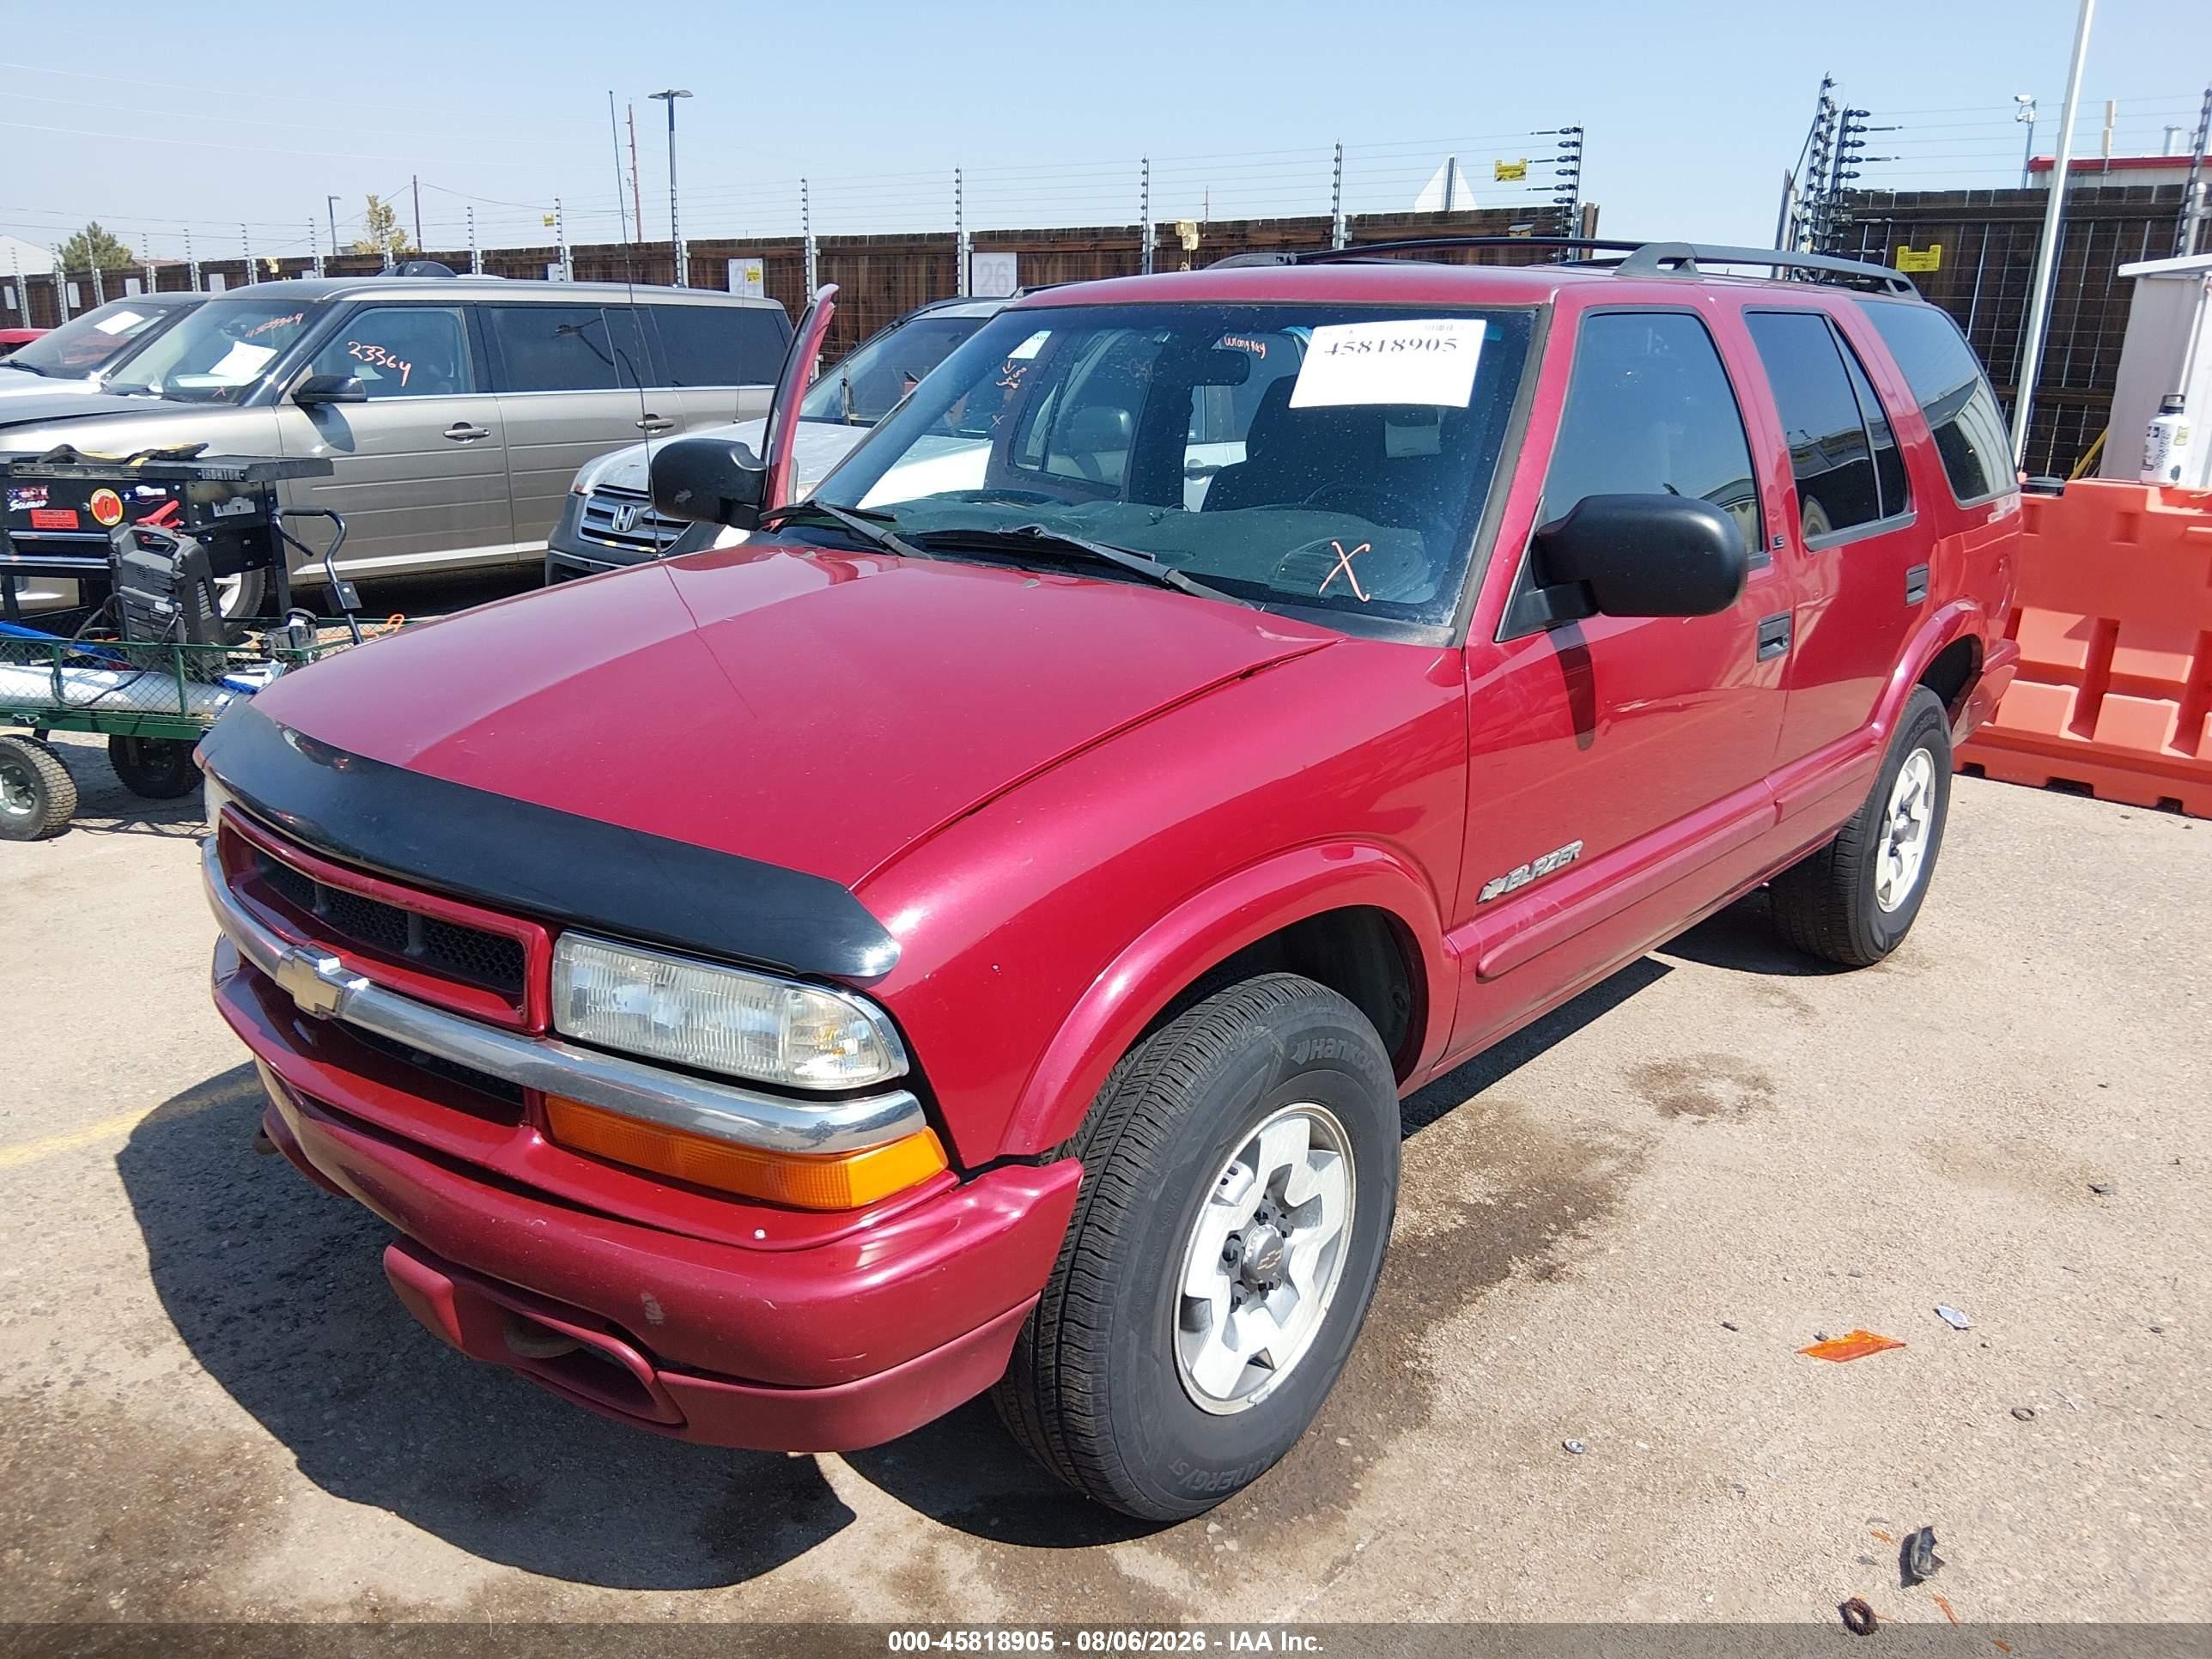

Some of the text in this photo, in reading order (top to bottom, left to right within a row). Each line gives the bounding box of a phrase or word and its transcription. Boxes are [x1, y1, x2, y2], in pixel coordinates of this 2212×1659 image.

[979, 260, 1010, 295] 26
[348, 340, 411, 387] 23364
[1324, 337, 1457, 356] 45818905
[1503, 839, 1583, 893] BLAZER
